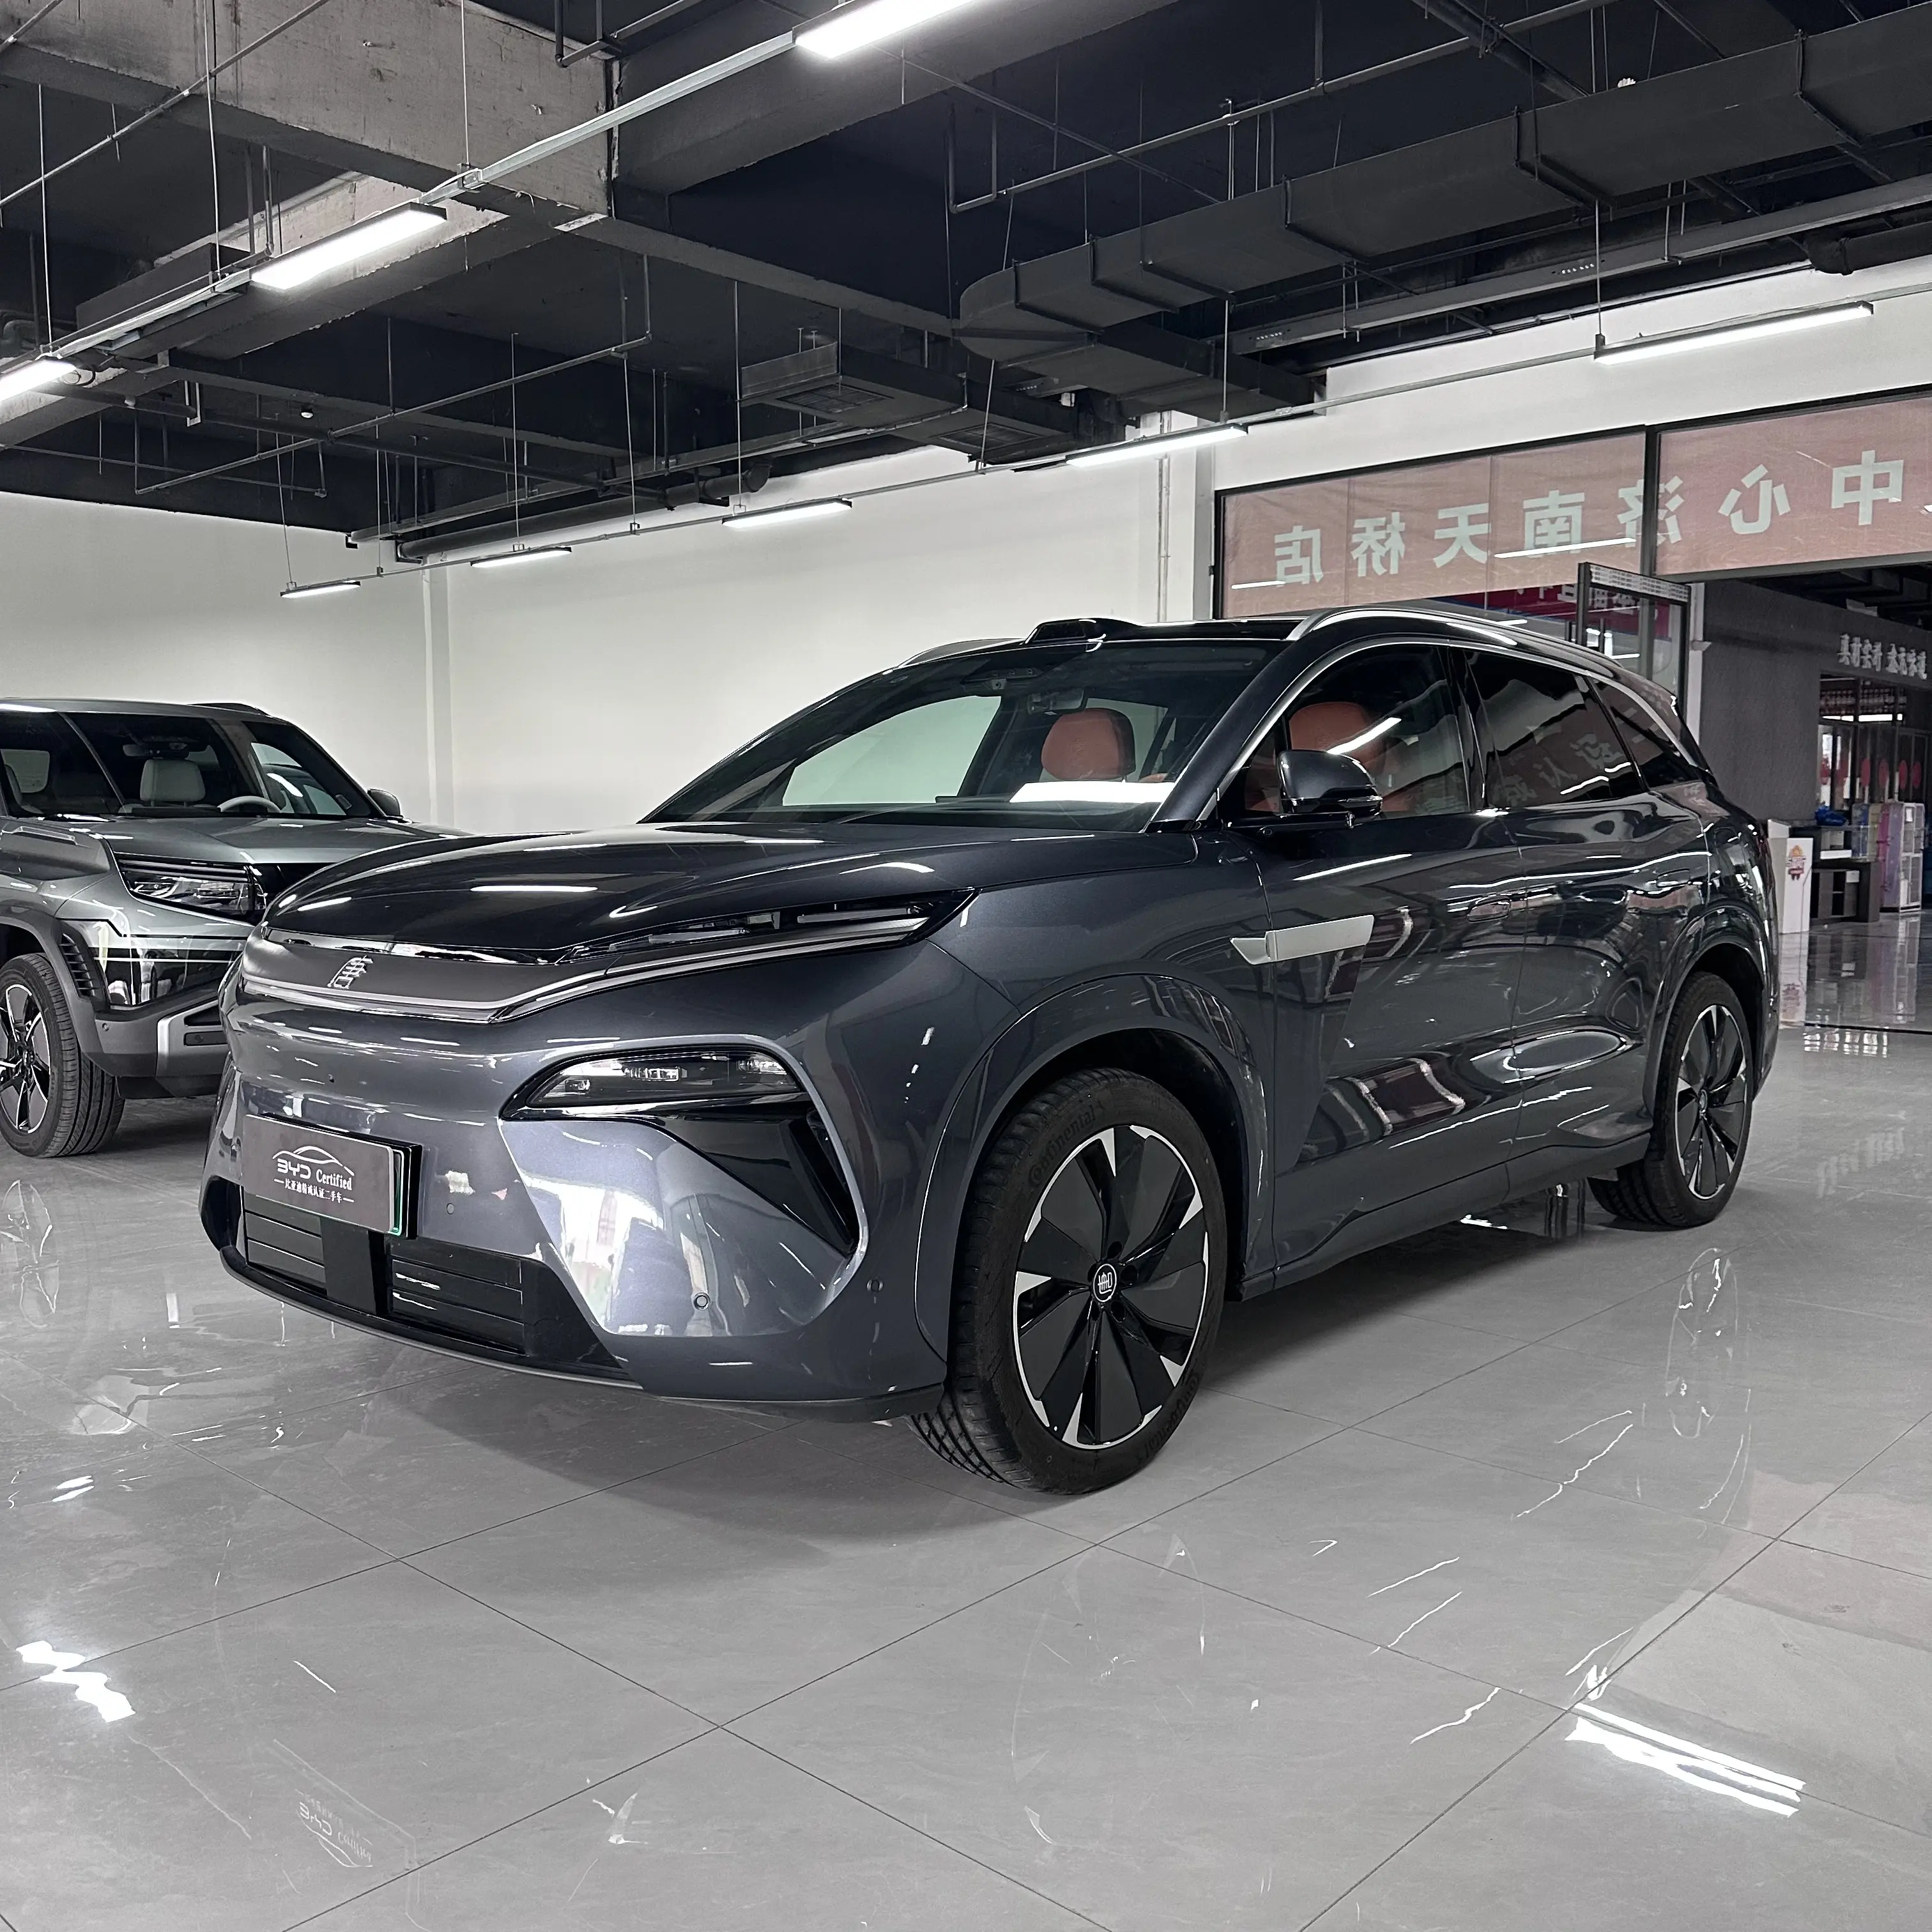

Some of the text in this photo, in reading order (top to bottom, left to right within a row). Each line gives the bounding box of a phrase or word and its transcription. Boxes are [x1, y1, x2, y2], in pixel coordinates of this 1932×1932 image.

[277, 1158, 352, 1191] BYD Certified
[1029, 1104, 1096, 1188] Continental
